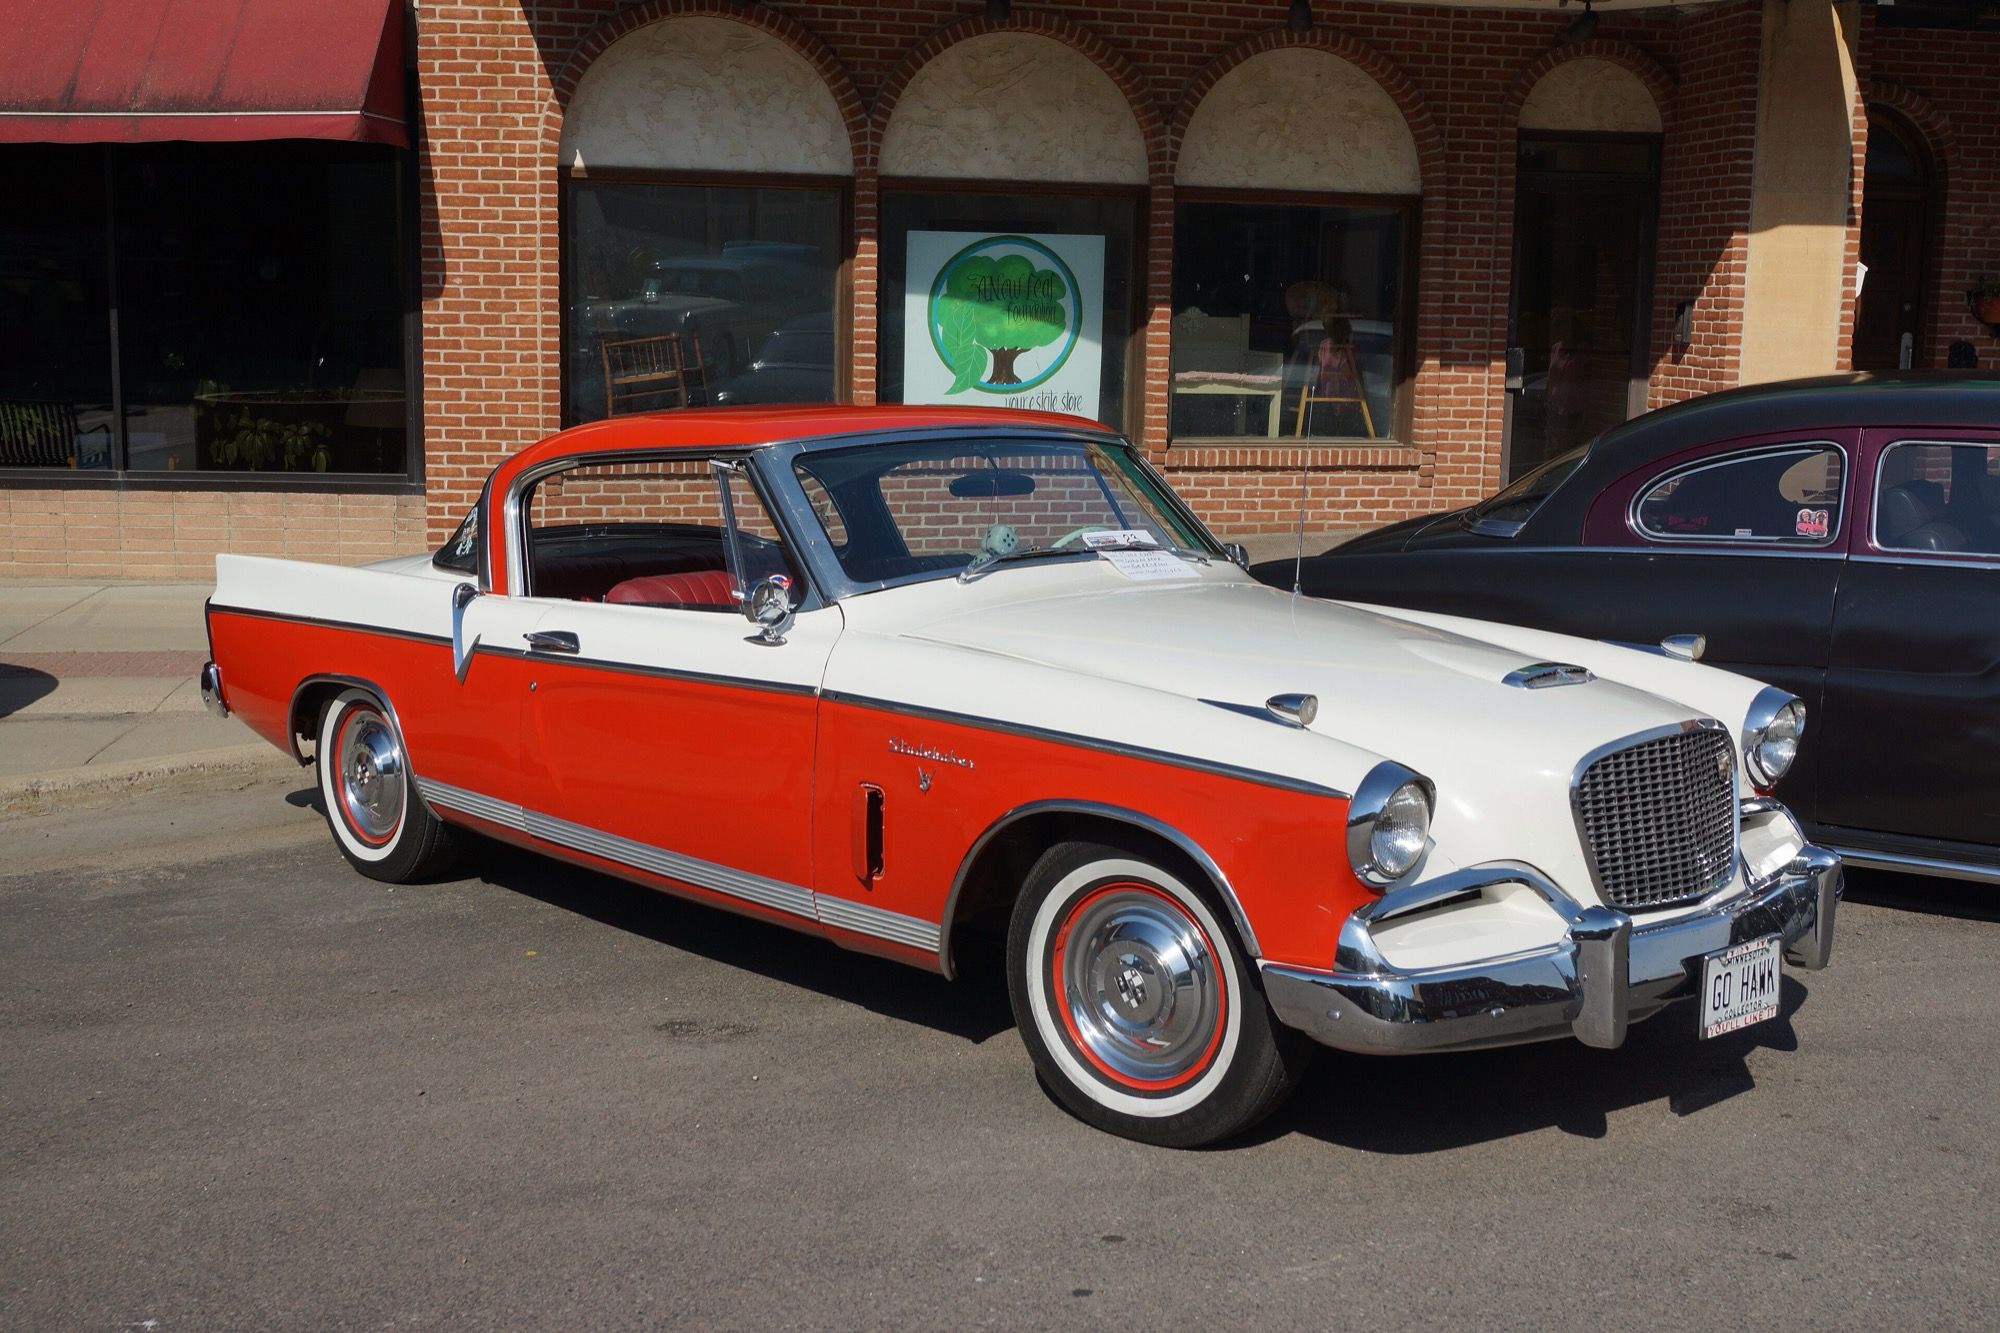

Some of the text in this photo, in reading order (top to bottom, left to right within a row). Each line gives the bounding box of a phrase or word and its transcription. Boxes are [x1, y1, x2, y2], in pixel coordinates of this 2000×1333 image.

[1060, 389, 1083, 412] store
[1712, 956, 1775, 1011] GO HAWK
[1709, 1006, 1776, 1036] YOU'LL LIKE IT
[1723, 999, 1763, 1020] COLLECTOR
